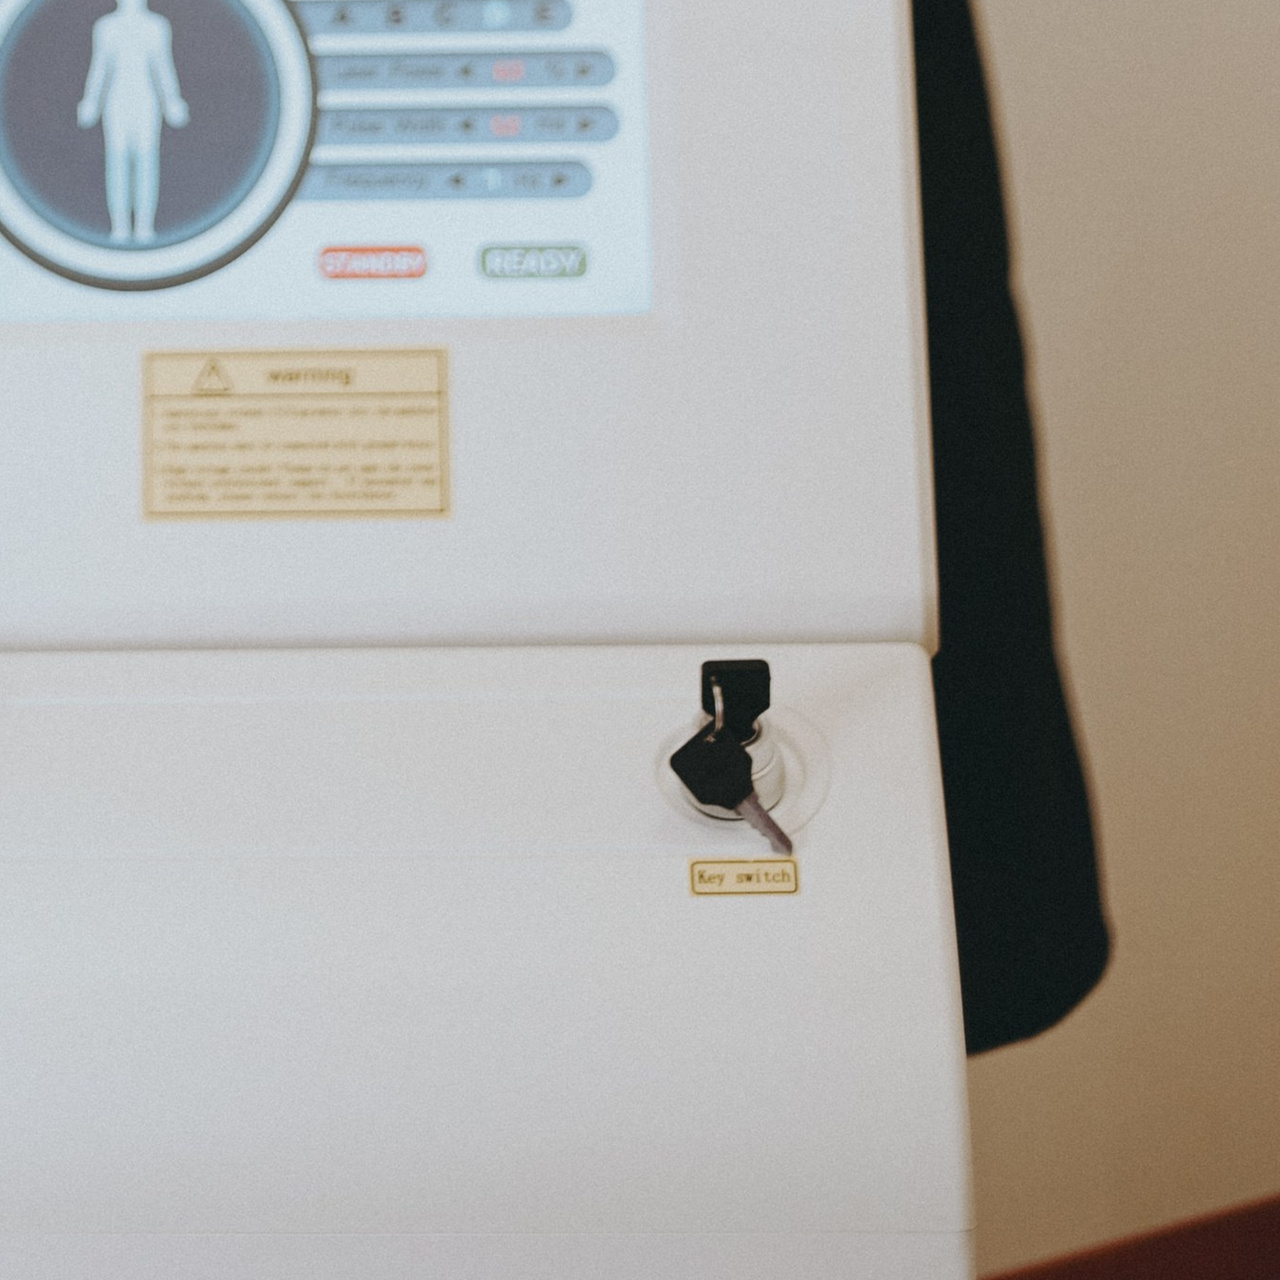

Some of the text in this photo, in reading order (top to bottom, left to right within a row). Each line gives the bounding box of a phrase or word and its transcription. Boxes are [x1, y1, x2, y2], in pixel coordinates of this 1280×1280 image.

[486, 250, 583, 275] READY
[696, 868, 792, 887] Key switch
